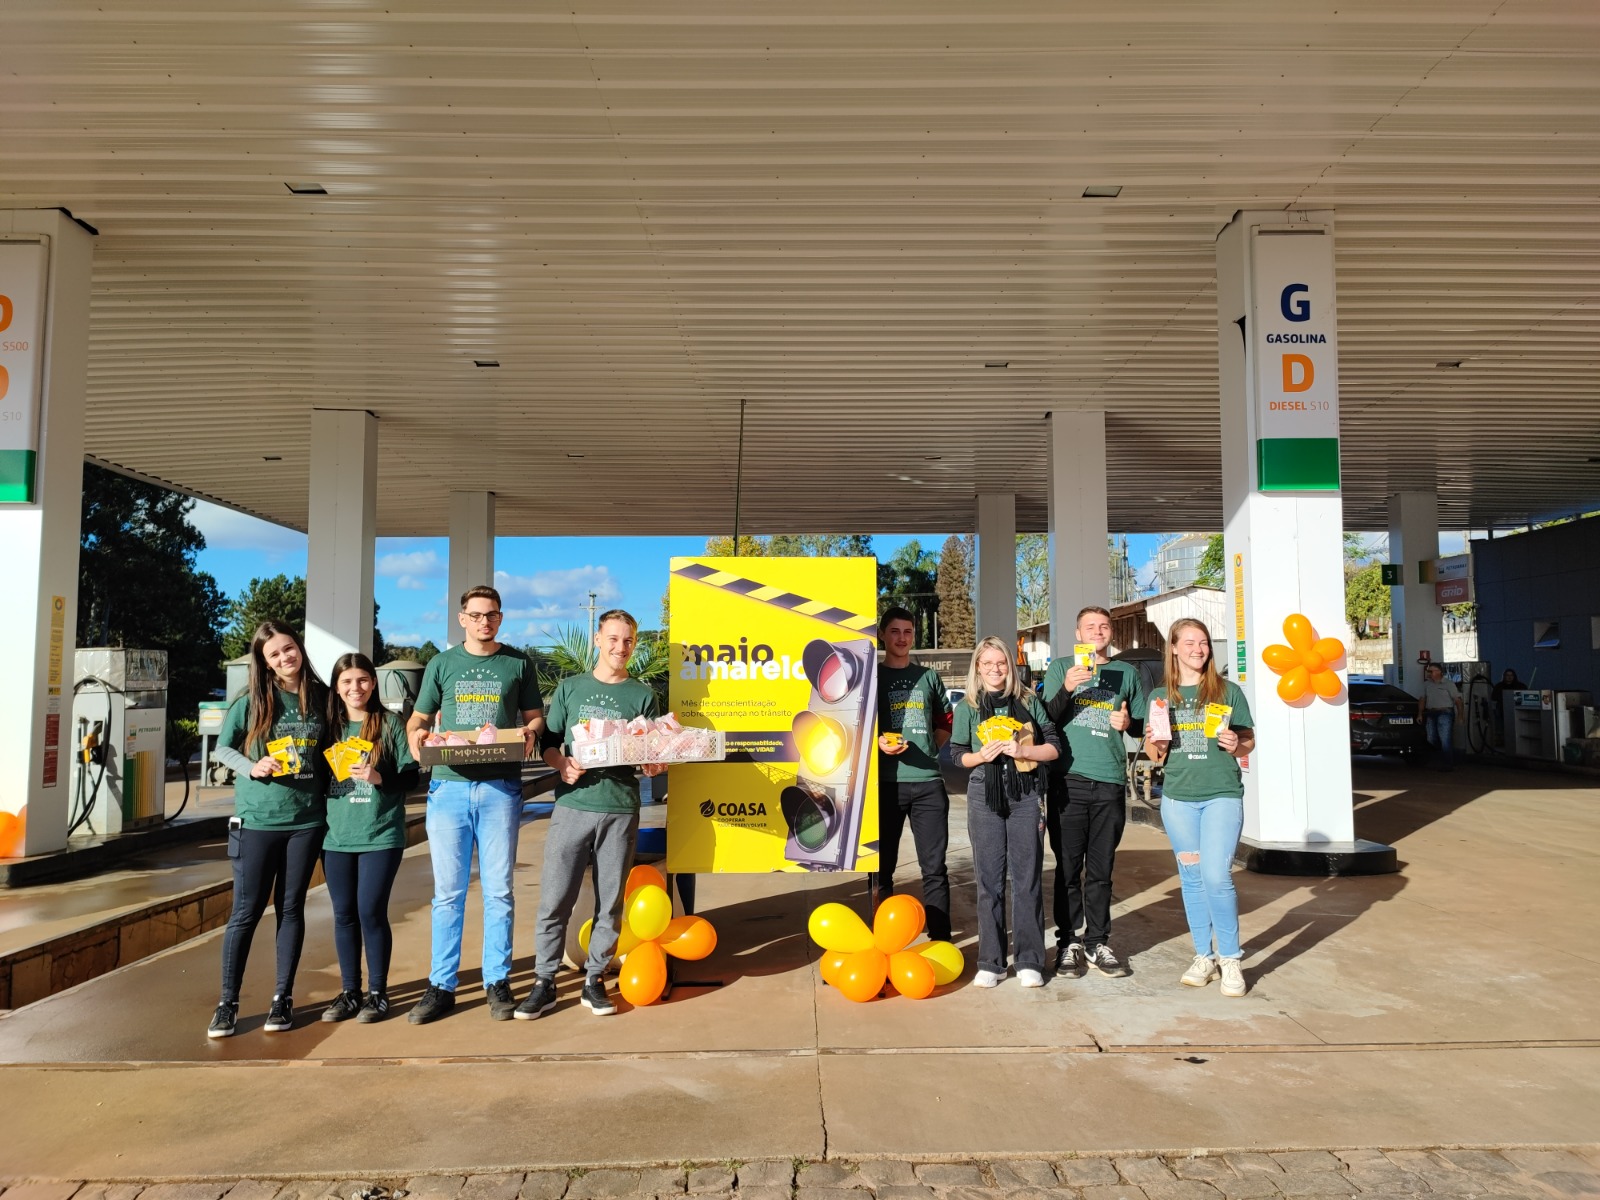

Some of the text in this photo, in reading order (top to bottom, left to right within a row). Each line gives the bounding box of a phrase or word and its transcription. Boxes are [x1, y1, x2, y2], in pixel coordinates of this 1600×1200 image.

[1280, 283, 1310, 322] G
[1266, 333, 1326, 343] GASOLINA
[2, 341, 29, 351] S500
[1282, 354, 1314, 392] D
[1269, 401, 1329, 411] DIESEL S10
[2, 411, 22, 421] S10
[1387, 570, 1393, 579] 3
[682, 636, 774, 666] maio
[680, 655, 807, 680] amarelo
[455, 694, 500, 703] COOPERATIVO
[681, 699, 776, 709] Mês de conscientização
[890, 702, 925, 711] COOPERATIVO
[1075, 698, 1114, 711] COOPERATIVO
[681, 709, 704, 717] sobre
[706, 710, 747, 719] segurança
[761, 709, 792, 717] trânsito
[455, 748, 507, 757] MONSTER
[718, 803, 766, 816] COASA
